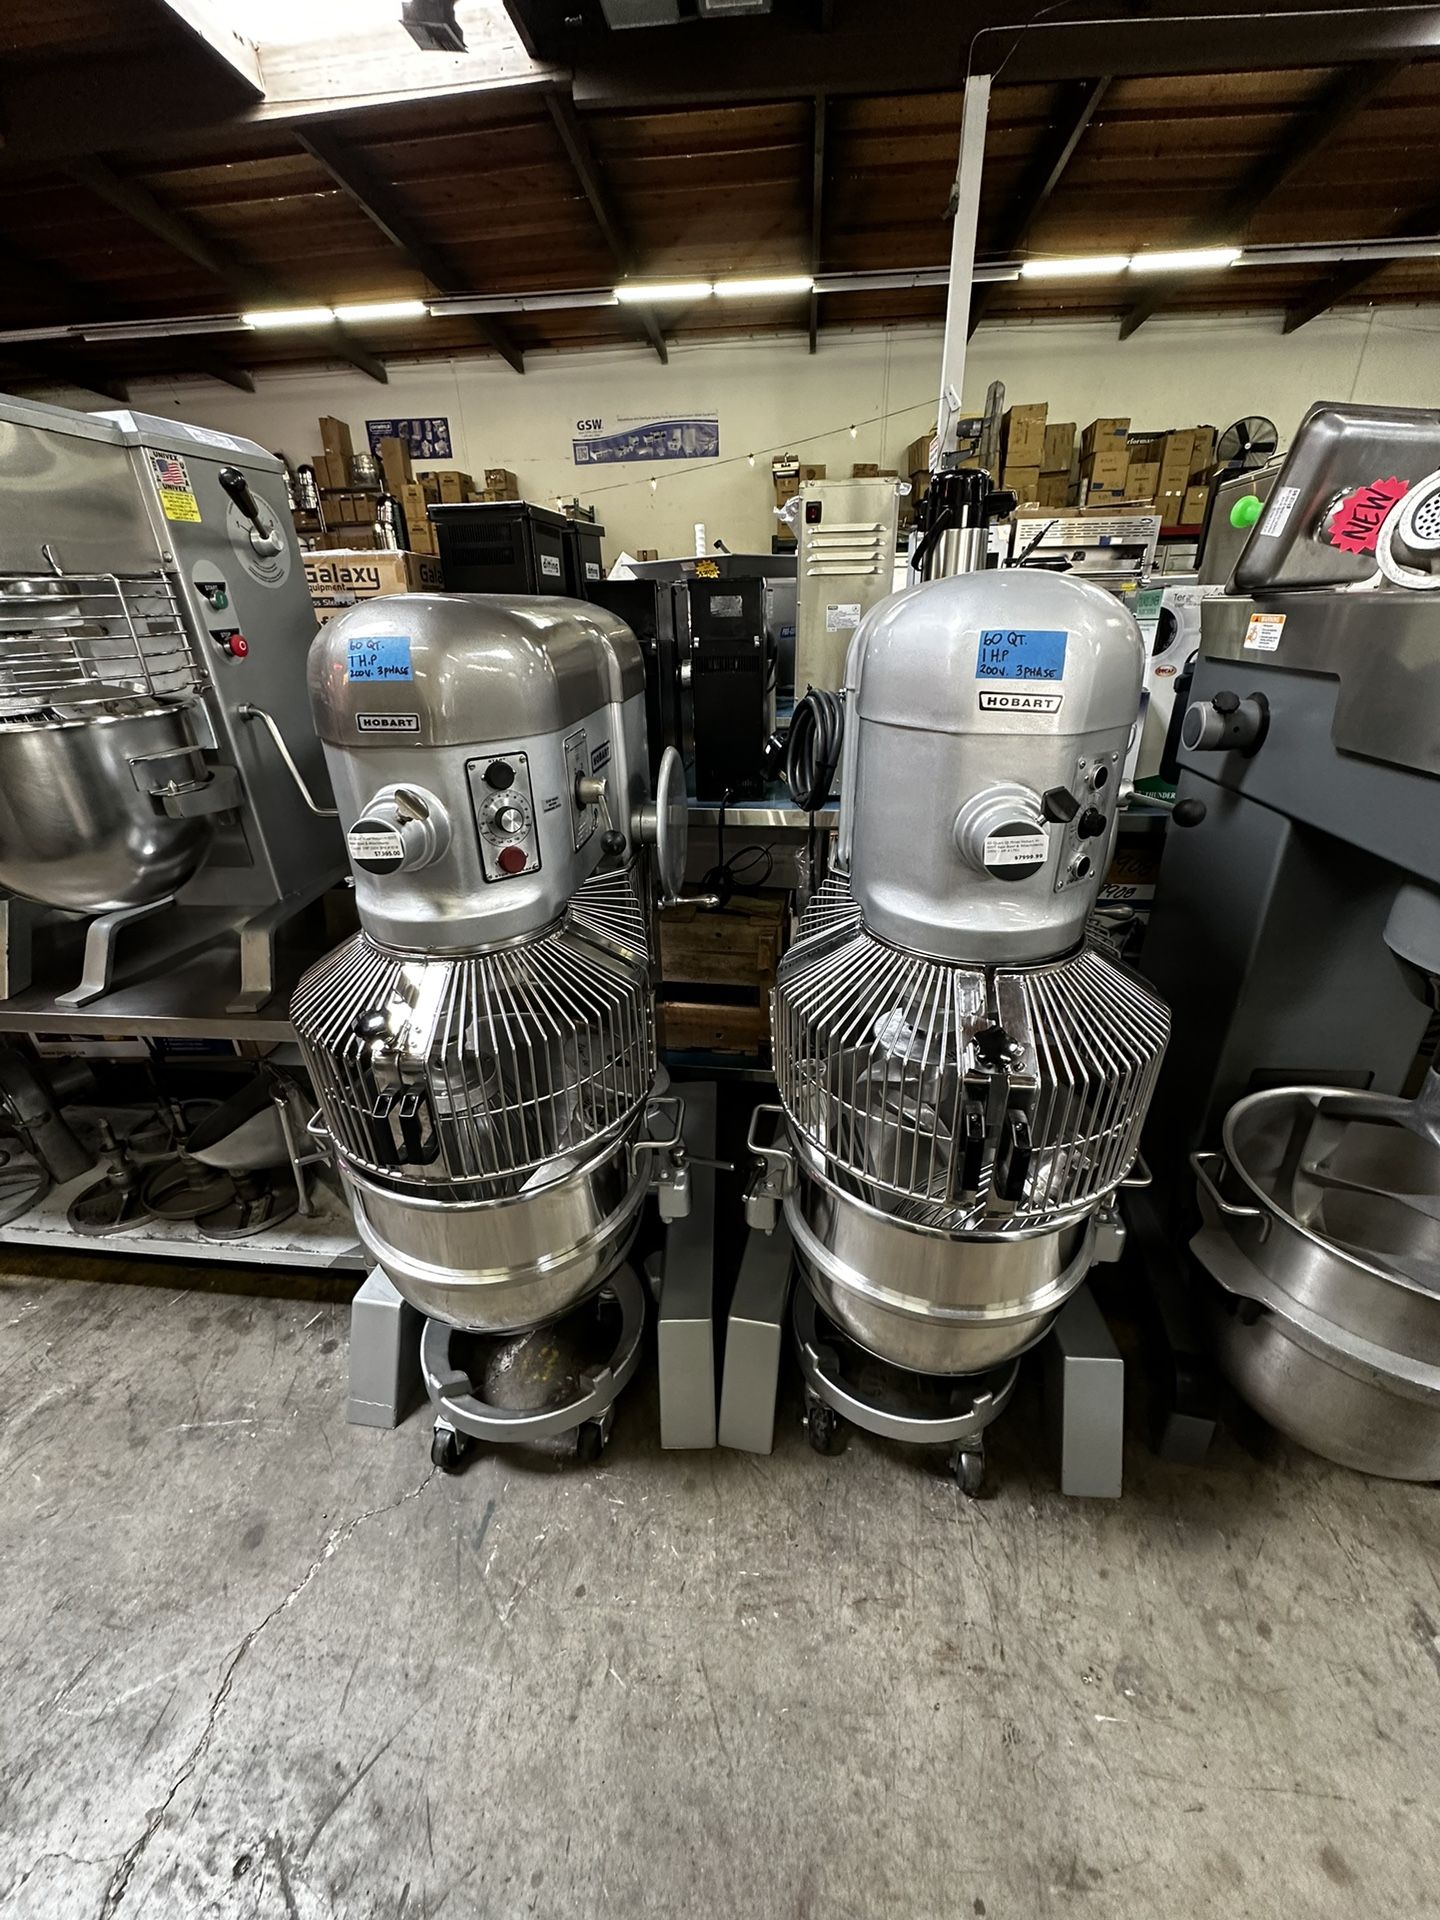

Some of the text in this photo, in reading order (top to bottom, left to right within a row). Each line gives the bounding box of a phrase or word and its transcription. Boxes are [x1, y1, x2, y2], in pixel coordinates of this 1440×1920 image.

[576, 419, 602, 430] GSW
[153, 451, 178, 461] UNIVEX
[162, 483, 187, 493] UNIVEX
[1341, 487, 1394, 541] NEW
[304, 563, 381, 590] Galaxy
[983, 631, 1028, 647] 60 QT.
[349, 641, 363, 651] 60
[986, 696, 1054, 709] HOBART
[363, 718, 414, 728] HOBART
[593, 746, 610, 766] HOBART
